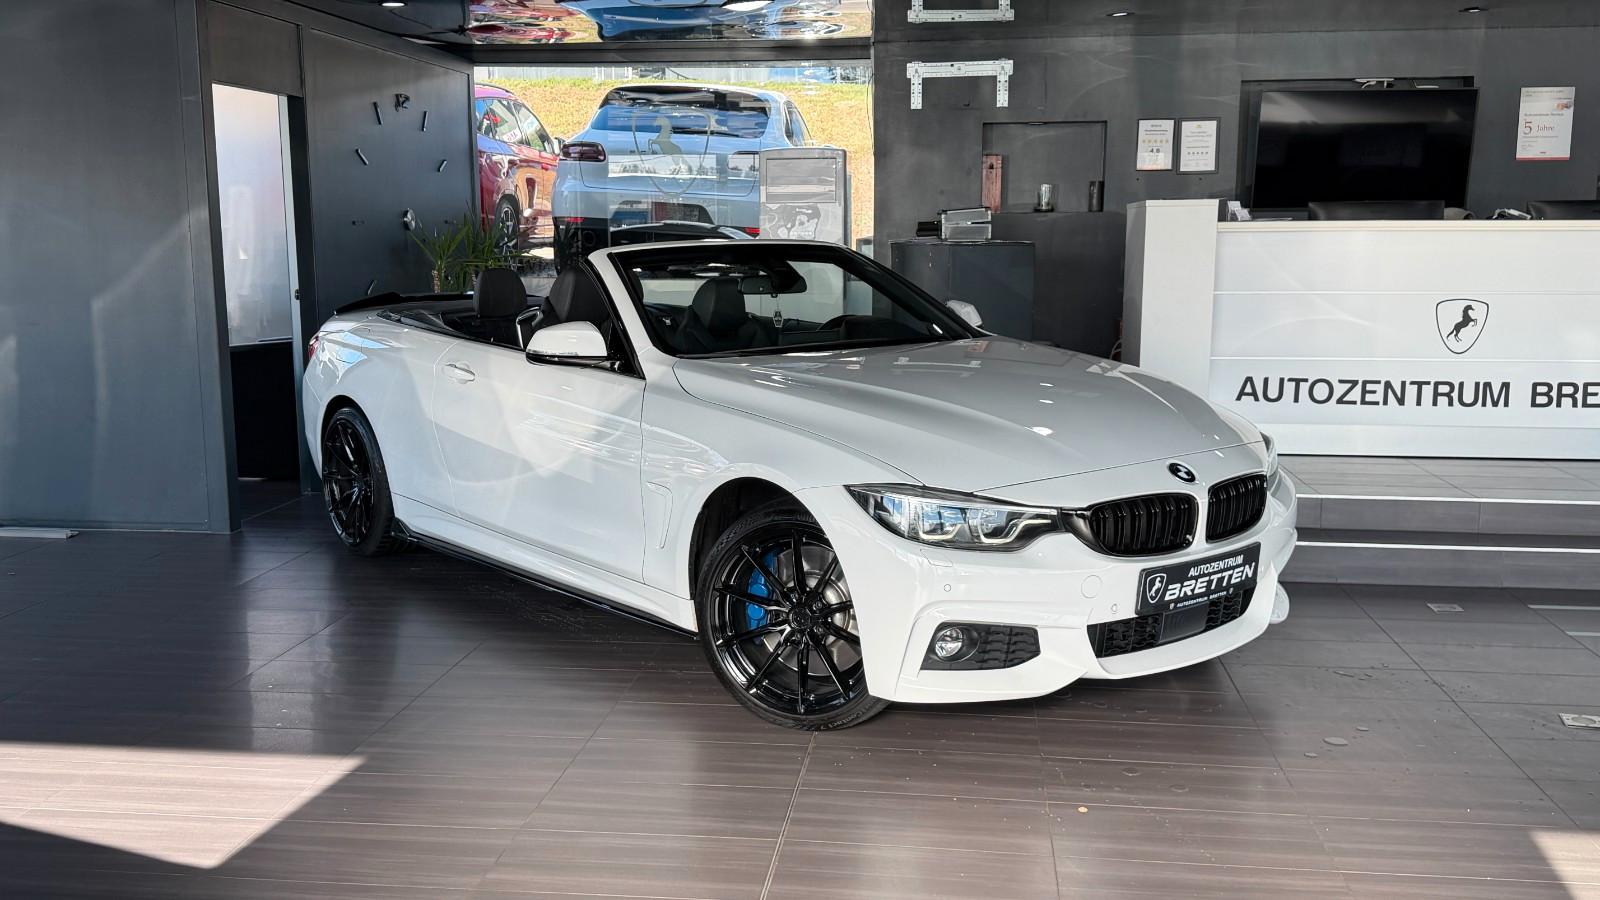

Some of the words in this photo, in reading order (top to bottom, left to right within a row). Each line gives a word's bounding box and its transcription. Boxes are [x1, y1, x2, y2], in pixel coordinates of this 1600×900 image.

[1523, 121, 1532, 135] 5
[1235, 375, 1511, 408] AUTOZENTRUM
[1530, 381, 1600, 408] BRE
[1187, 554, 1244, 577] AUTOZENTRUM
[1164, 562, 1256, 600] BRETTEN
